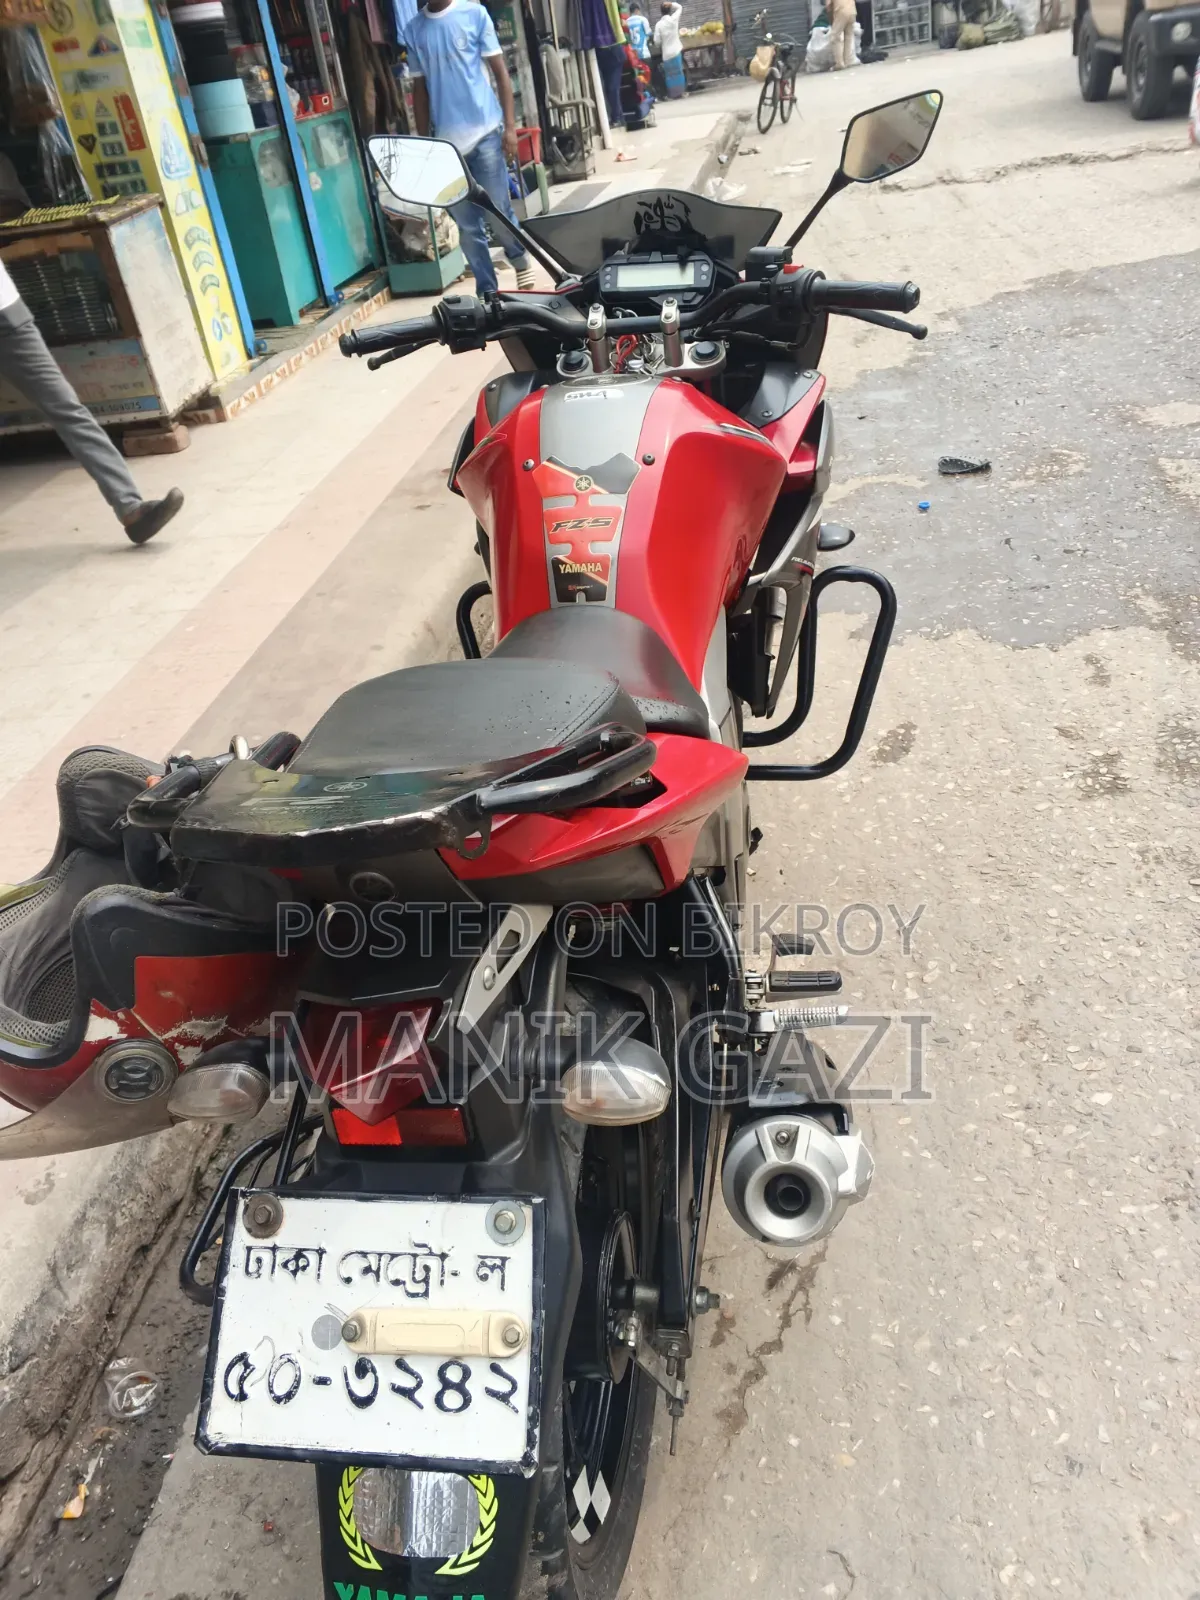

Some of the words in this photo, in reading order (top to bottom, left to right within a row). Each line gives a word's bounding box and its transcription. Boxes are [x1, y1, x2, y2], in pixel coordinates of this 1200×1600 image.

[559, 563, 603, 574] YAMAHA
[244, 1242, 327, 1281] ঢাকা
[476, 1253, 512, 1293] ল
[223, 1351, 520, 1415] ৫০-৩২৪২
